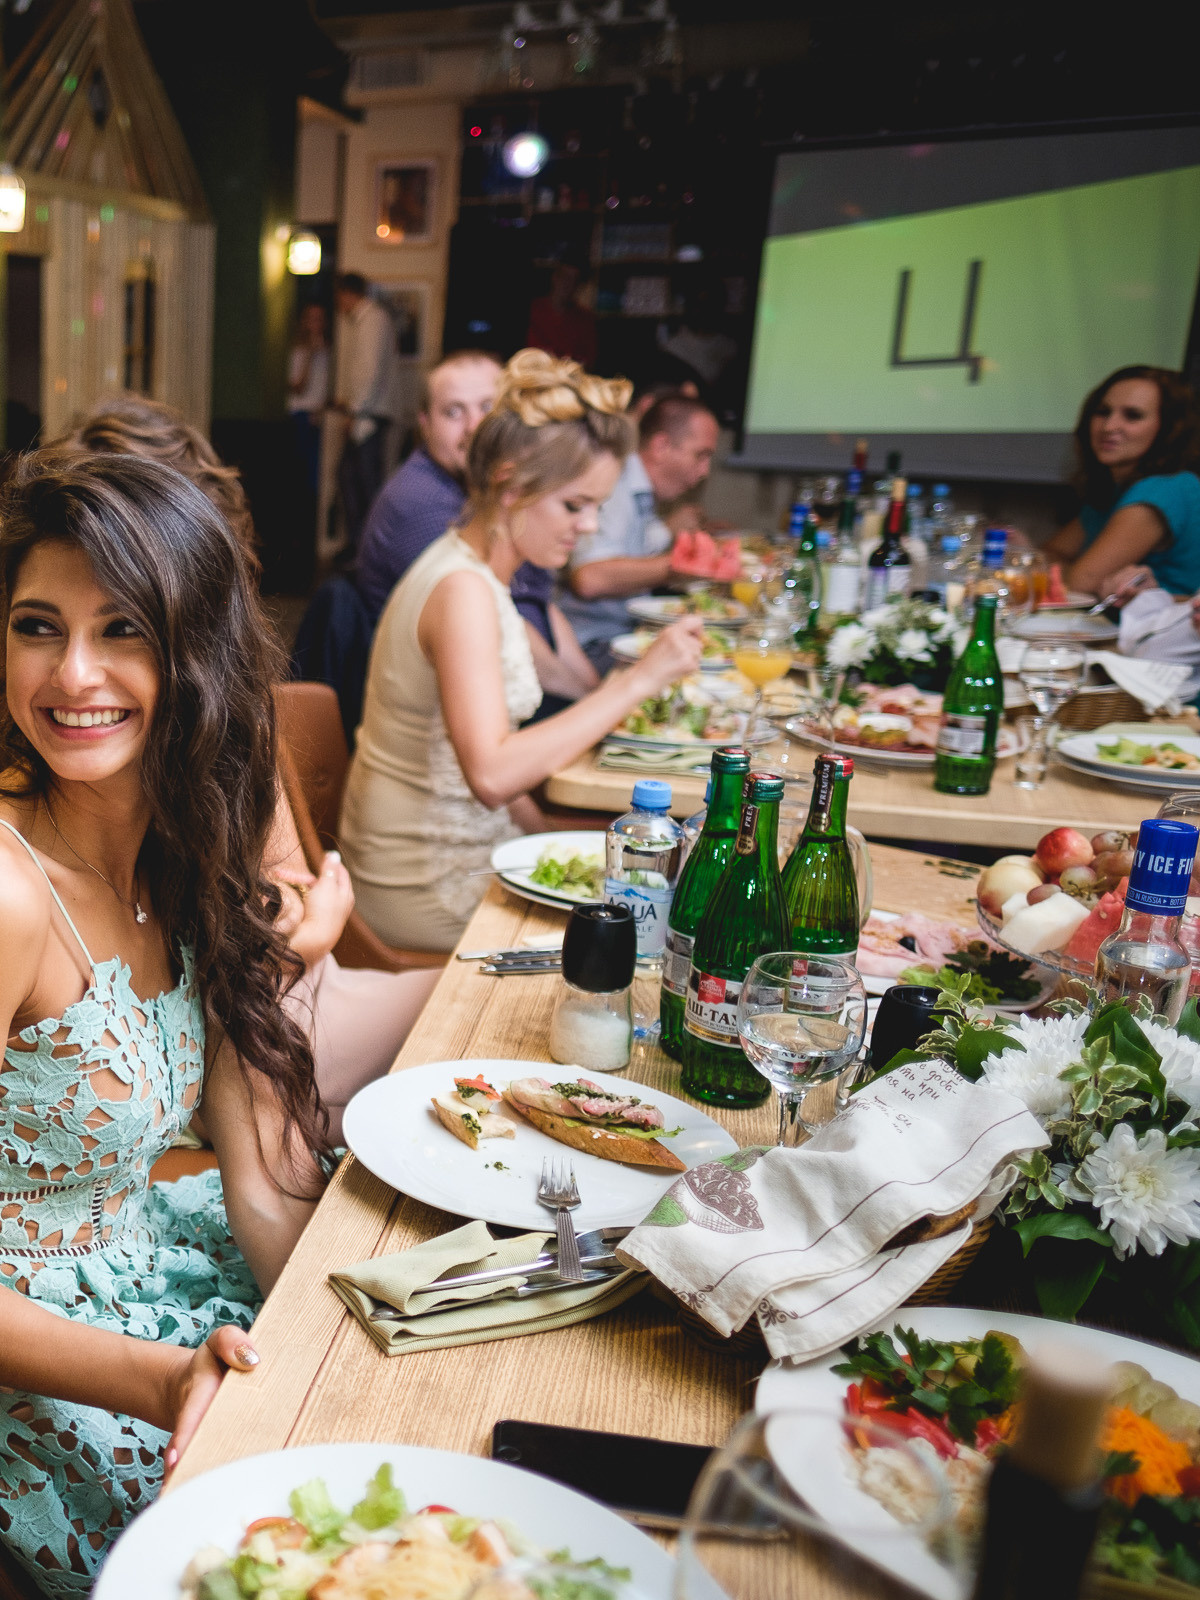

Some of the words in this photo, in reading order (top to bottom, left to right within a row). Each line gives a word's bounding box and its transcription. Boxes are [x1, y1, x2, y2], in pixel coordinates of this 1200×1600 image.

[890, 259, 983, 385] Ц
[818, 763, 832, 806] PREMIUM
[1147, 854, 1175, 875] ICE
[1141, 894, 1162, 905] RUSSIA
